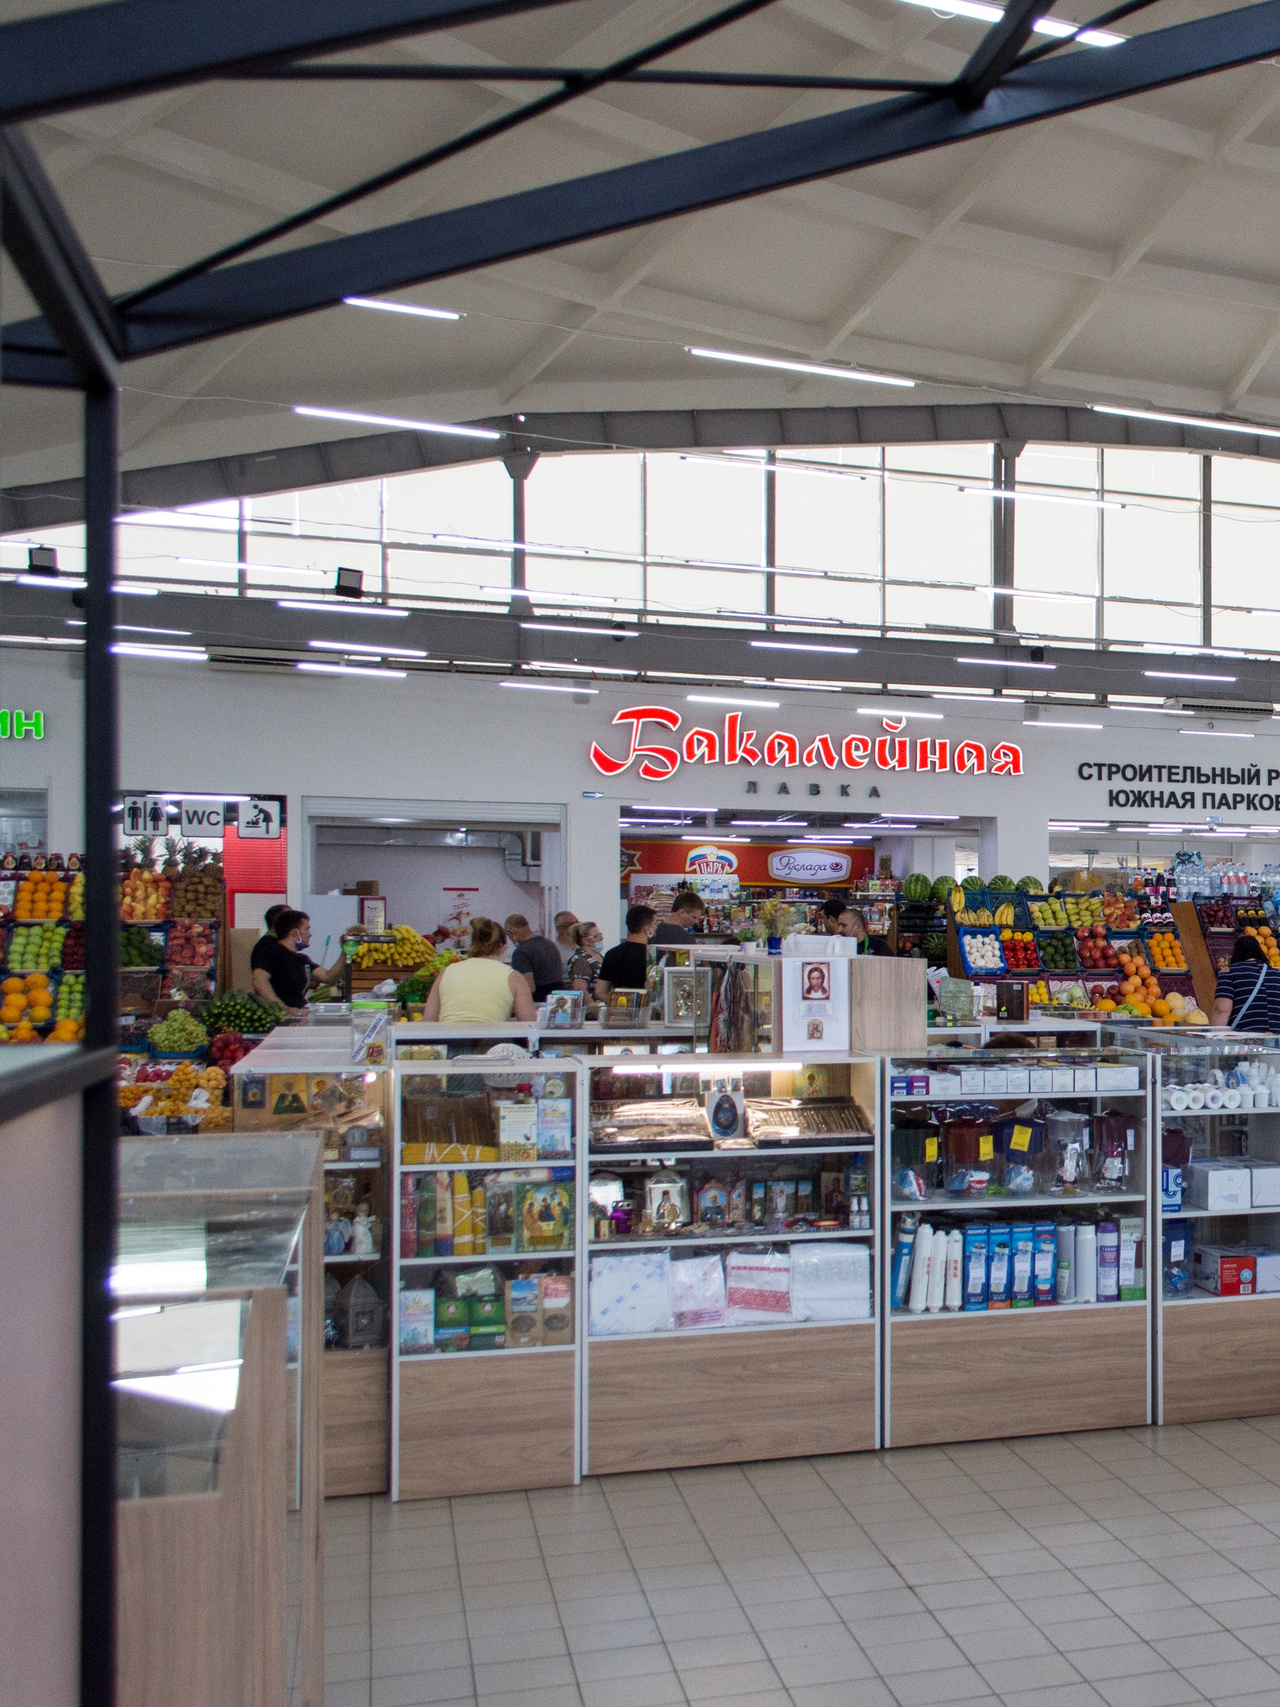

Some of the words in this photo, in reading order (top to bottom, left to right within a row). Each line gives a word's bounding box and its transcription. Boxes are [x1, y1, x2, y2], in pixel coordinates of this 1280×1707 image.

[589, 704, 1024, 781] Бакалейная
[1077, 762, 1262, 787] СТРОИТЕЛЬНЫЙ
[745, 780, 882, 799] ЛАВКА
[1107, 789, 1196, 811] ЮЖНАЯ
[185, 809, 222, 827] WC
[775, 855, 828, 877] Руслада
